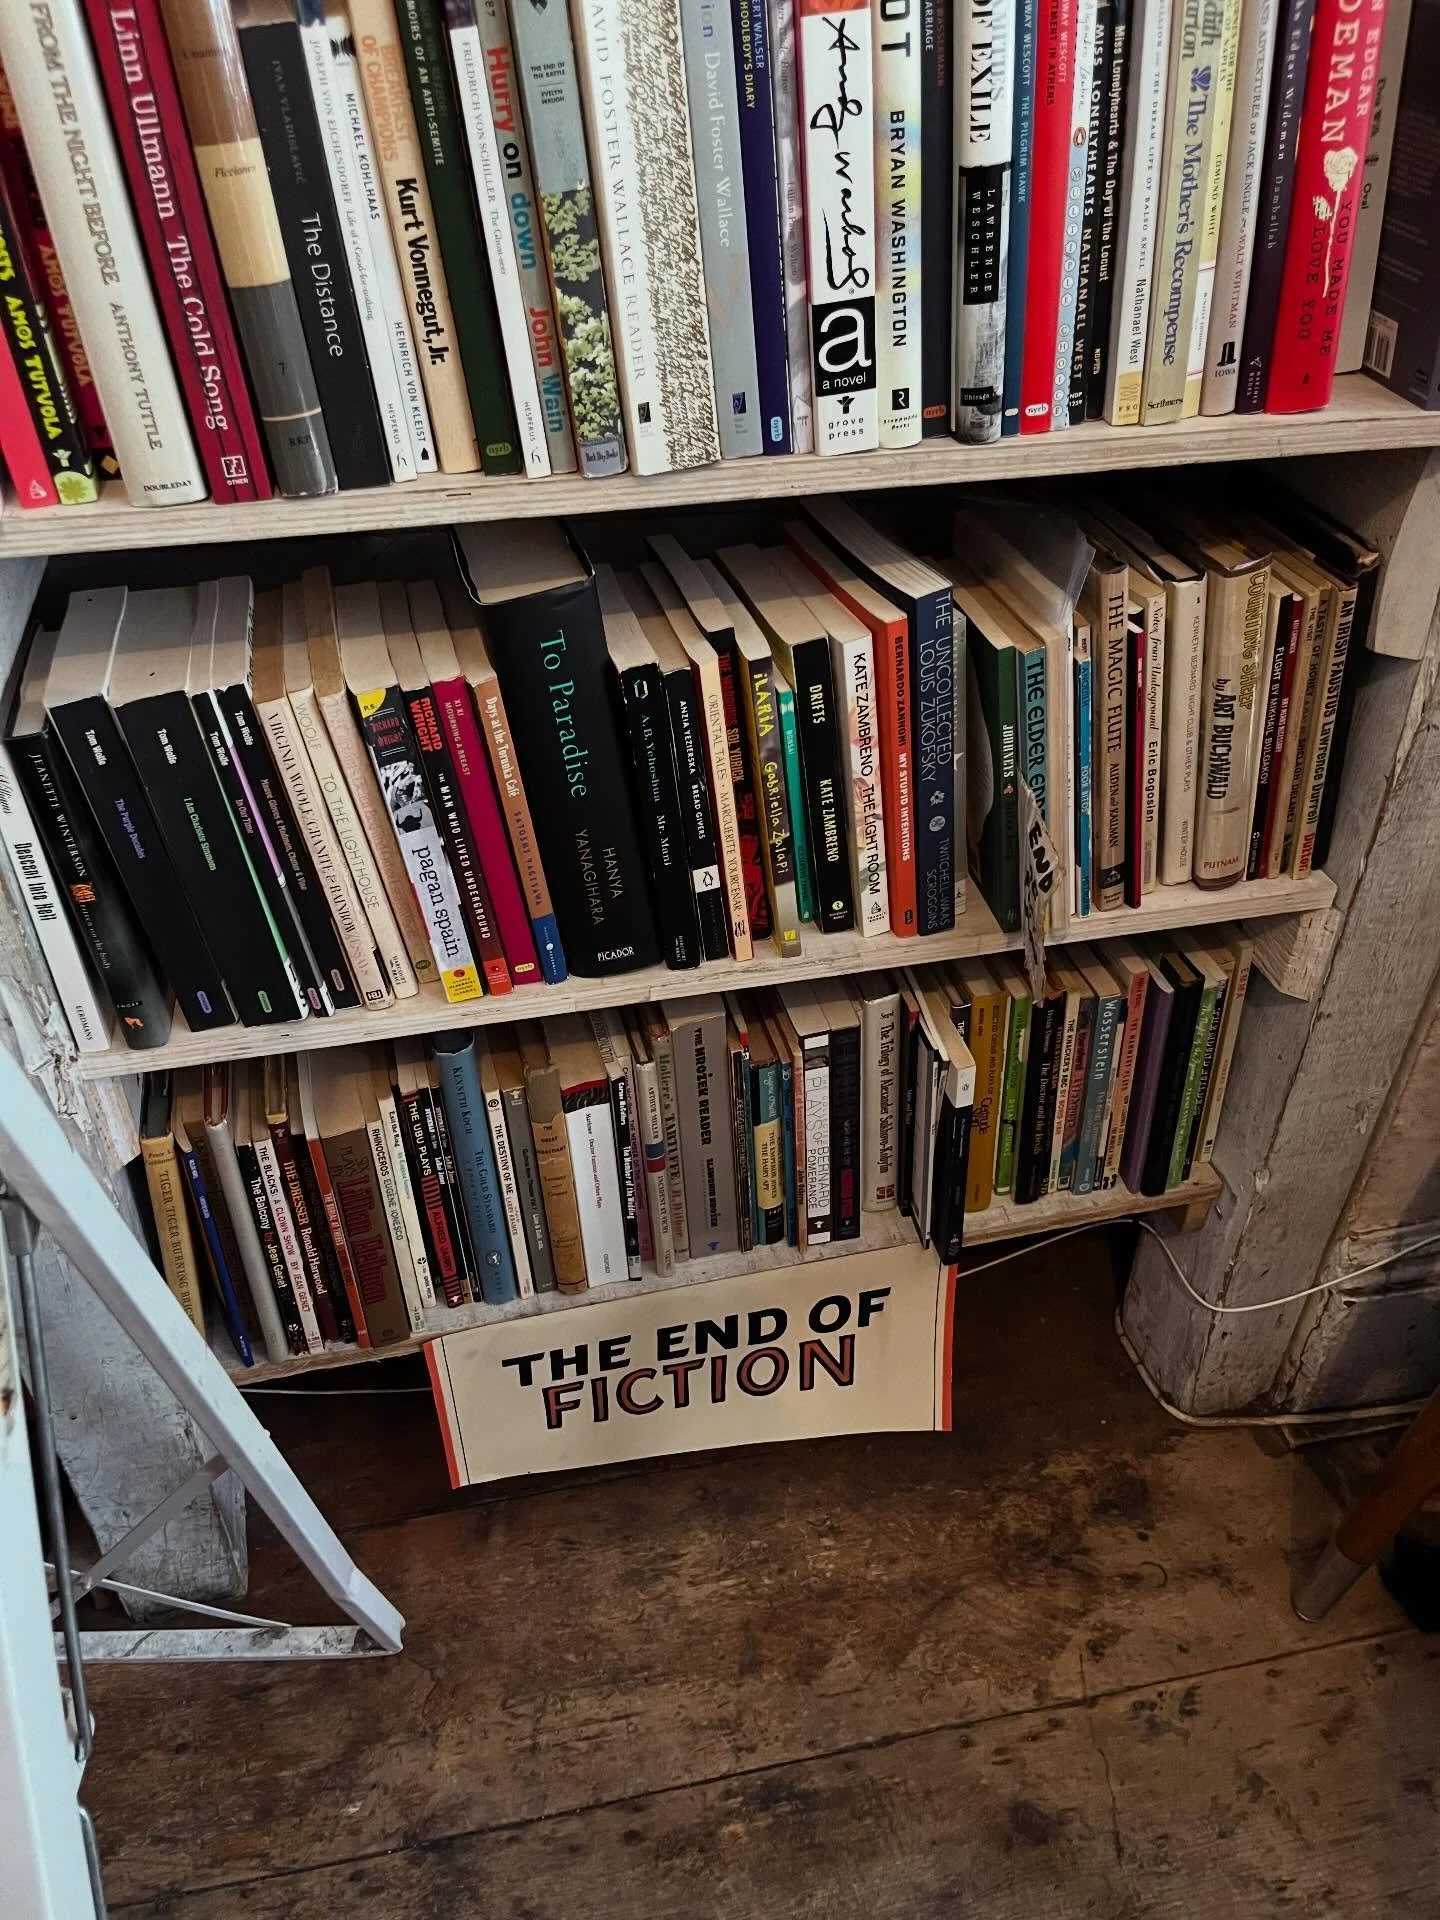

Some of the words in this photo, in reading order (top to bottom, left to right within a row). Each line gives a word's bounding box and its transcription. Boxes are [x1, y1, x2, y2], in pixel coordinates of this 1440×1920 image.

[29, 2, 64, 72] FROM
[111, 9, 146, 83] Linn
[1092, 25, 1104, 66] MISS
[1112, 25, 1126, 55] Miss
[50, 76, 79, 124] THE
[488, 46, 516, 133] Hurry
[703, 52, 723, 107] David
[810, 18, 864, 149] Andy
[1107, 59, 1122, 135] Lonelyhearts
[345, 93, 367, 150] MICHAEL
[1186, 94, 1208, 136] The
[64, 128, 97, 198] NIGHT
[130, 93, 177, 219] Ullmann
[502, 141, 525, 178] on
[711, 115, 726, 172] Foster
[890, 111, 906, 188] BRYAN
[1085, 80, 1102, 216] LONELYHEARTS
[1105, 155, 1118, 175] The
[1108, 141, 1119, 150] &
[356, 154, 381, 220] KOHLHAAS
[1101, 180, 1115, 203] Day
[1175, 142, 1202, 235] Mother's
[513, 193, 538, 270] down
[599, 74, 622, 167] FOSTER
[611, 178, 636, 285] WALLACE
[626, 295, 647, 381] READER
[716, 178, 734, 248] Wallace
[1101, 223, 1112, 241] the
[1102, 206, 1113, 219] of
[1336, 200, 1354, 245] YOU
[83, 202, 120, 286] BEFORE
[165, 236, 196, 289] The
[970, 191, 981, 295] WESCHLER
[984, 189, 996, 292] LAWRENCE
[1098, 244, 1110, 282] Locust
[1305, 225, 1325, 285] LOVE
[300, 212, 324, 257] The
[312, 265, 345, 358] Distance
[396, 179, 419, 232] Kurt
[408, 236, 442, 342] Vonnegut,
[426, 345, 449, 365] Jr.
[891, 199, 906, 347] WASHINGTON
[1076, 229, 1093, 331] NATHANAEL
[1326, 258, 1345, 321] MADE
[1130, 278, 1146, 333] Nathanael
[1162, 241, 1192, 366] Recompense
[1297, 299, 1317, 341] YOU
[110, 302, 144, 384] ANTHONY
[184, 297, 217, 358] Cold
[393, 322, 412, 378] HEINRICH
[530, 307, 556, 367] John
[818, 309, 872, 372] a
[1318, 331, 1335, 357] ME
[1072, 338, 1084, 379] WEST
[1128, 336, 1142, 365] West
[198, 365, 229, 431] Song
[406, 381, 418, 403] VON
[833, 372, 865, 387] novel
[134, 388, 163, 451] TUTTLE
[410, 407, 426, 442] KLEIST
[542, 373, 568, 433] Wain
[829, 418, 863, 428] grove
[829, 429, 863, 440] press
[934, 593, 952, 627] THE
[1108, 591, 1125, 630] THE
[1339, 600, 1355, 618] AN
[540, 629, 566, 671] To
[1334, 621, 1352, 658] IRISH
[853, 653, 868, 692] KATE
[920, 640, 936, 693] LOUIS
[1027, 658, 1045, 702] THE
[1107, 638, 1124, 700] MAGIC
[1212, 678, 1231, 692] by
[1272, 646, 1285, 682] FLIGHT
[809, 684, 826, 725] DRIFTS
[933, 638, 952, 765] UNCOLLECTED
[1213, 693, 1235, 721] ART
[1269, 684, 1280, 696] BY
[1323, 661, 1345, 718] FAUSTUS
[409, 700, 432, 753] WRIGHT
[421, 697, 443, 750] RICHARD
[679, 700, 690, 728] ANZIA
[855, 693, 874, 777] ZAMBRENO
[1028, 706, 1046, 766] ELDER
[1106, 705, 1123, 754] FLUTE
[1264, 698, 1279, 736] MIKHAIL
[548, 680, 591, 800] Paradise
[683, 729, 697, 774] YEZIERSKA
[899, 753, 908, 766] MY
[920, 701, 937, 782] ZUKOFSKY
[1002, 724, 1016, 778] JOURNEYS
[1147, 741, 1158, 767] Eric
[1206, 725, 1233, 800] BUCHWALD
[1259, 738, 1273, 784] BULGAKOV
[1313, 721, 1335, 781] Lawrence
[440, 786, 456, 809] MAN
[691, 784, 702, 811] BREAD
[820, 779, 835, 806] KATE
[862, 784, 875, 813] THE
[899, 768, 909, 805] STUPID
[1145, 769, 1157, 823] Bogosian
[1306, 784, 1324, 825] Durrell
[29, 754, 59, 811] JEANETTE
[55, 813, 88, 877] WINTERSON
[448, 812, 462, 836] WHO
[695, 812, 706, 840] GIVERS
[822, 807, 840, 862] ZAMBRENO
[864, 815, 879, 854] LIGHT
[900, 807, 911, 861] INTENTIONS
[14, 842, 41, 880] Descent
[321, 772, 335, 792] TO
[330, 797, 346, 825] THE
[339, 829, 380, 910] LIGHTHOUSE
[455, 838, 470, 869] LIVED
[1027, 822, 1061, 894] END
[1298, 833, 1316, 872] Dutton
[24, 882, 48, 901] Into
[574, 828, 604, 926] YANAGIHARA
[602, 847, 623, 898] HANYA
[868, 855, 881, 895] ROOM
[30, 902, 57, 921] Hell
[413, 845, 444, 906] pagan
[430, 908, 463, 958] spain
[462, 871, 491, 940] UNDERGROUND
[596, 946, 634, 962] PICADOR
[878, 1041, 893, 1067] Trilogy
[881, 1024, 892, 1039] The
[1094, 1000, 1117, 1080] Wasserstein
[880, 1069, 892, 1077] of
[409, 1102, 419, 1122] THE
[880, 1079, 892, 1115] Alexander
[413, 1124, 425, 1144] UBU
[495, 1124, 503, 1139] THE
[699, 1100, 712, 1145] READER
[371, 1128, 390, 1177] RHINOCEROS
[417, 1146, 432, 1176] PLAYS
[497, 1140, 509, 1171] DESTINY
[250, 1178, 264, 1195] The
[503, 1172, 510, 1182] OF
[504, 1183, 513, 1195] ME
[252, 1195, 272, 1230] Balcony
[267, 1243, 280, 1264] Jean
[274, 1264, 287, 1289] Genet
[502, 1334, 631, 1386] THE
[656, 1306, 789, 1360] END
[808, 1287, 892, 1334] OF
[542, 1333, 856, 1429] FICTION
